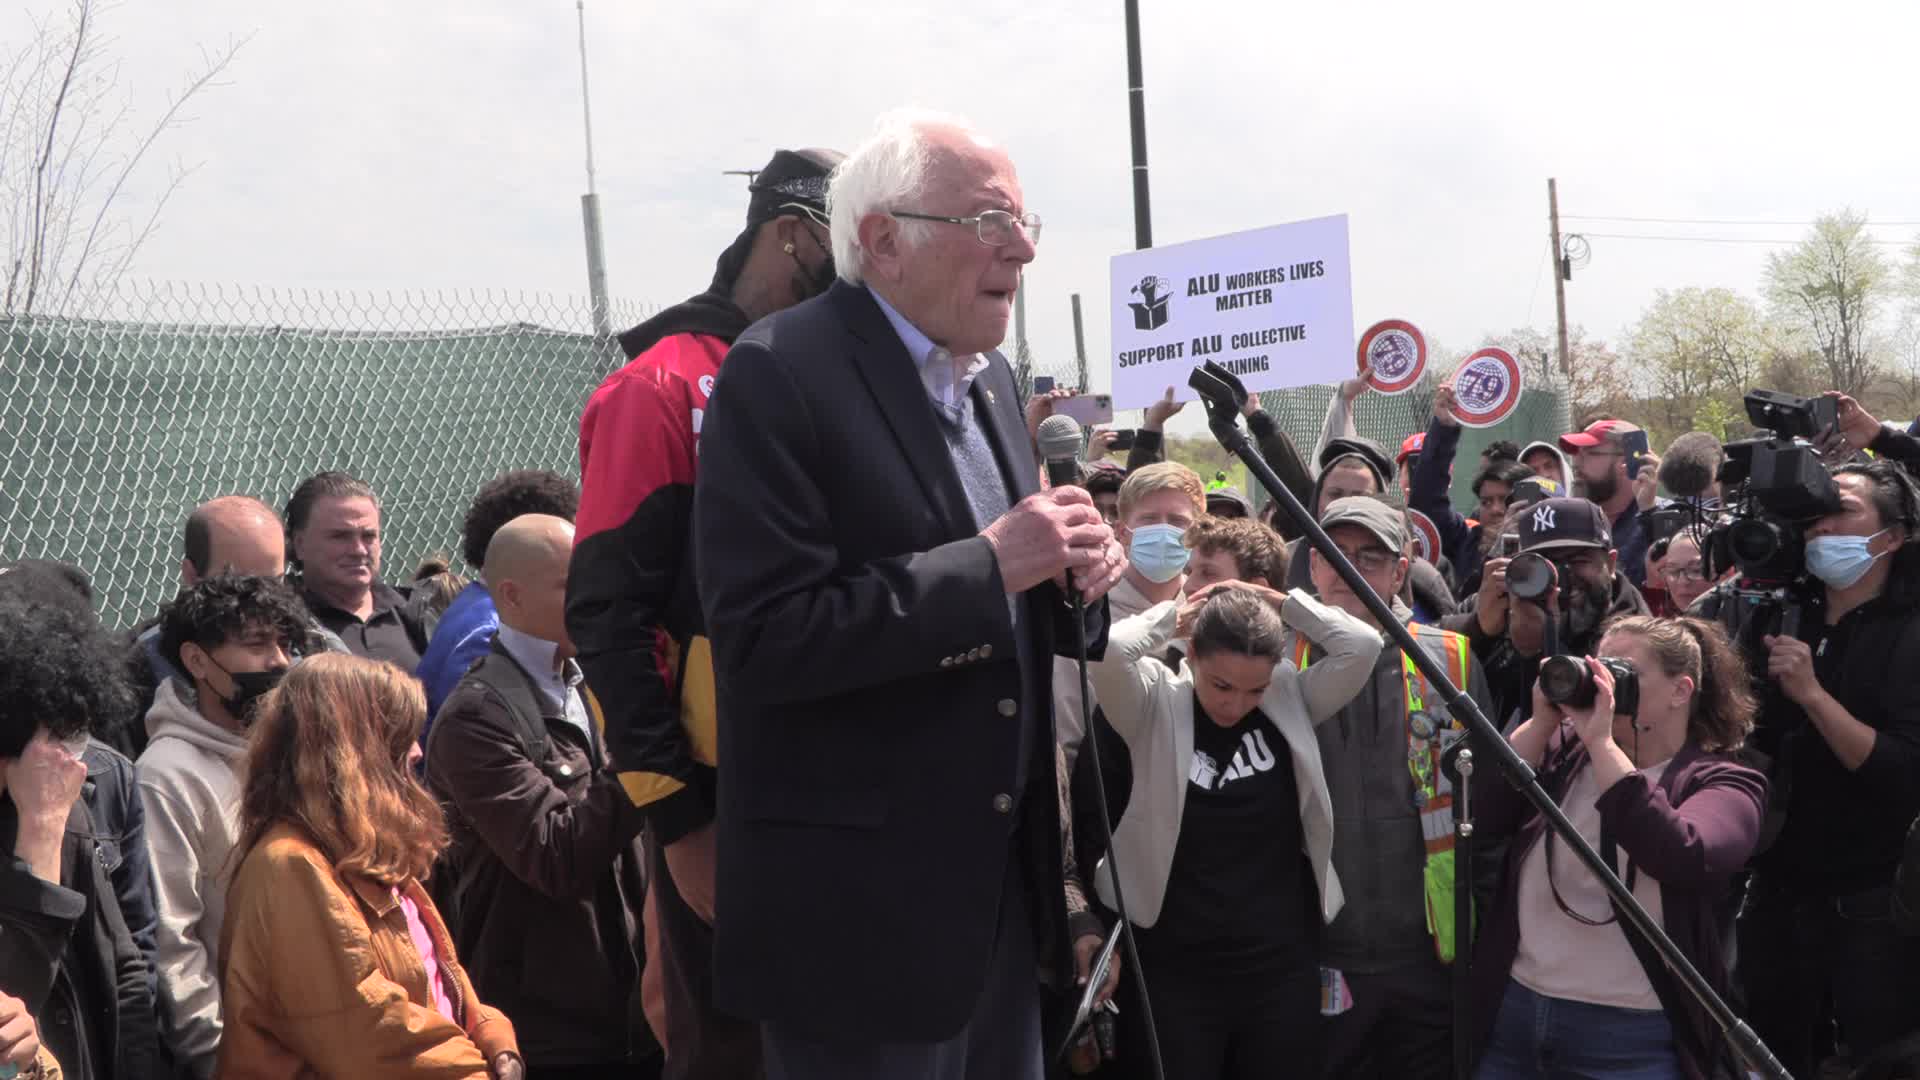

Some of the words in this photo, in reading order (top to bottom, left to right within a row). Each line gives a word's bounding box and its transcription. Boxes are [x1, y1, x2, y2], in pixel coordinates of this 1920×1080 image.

[1187, 273, 1220, 296] ALU
[1226, 267, 1285, 291] WORKERS
[1290, 260, 1324, 281] LIVES
[1216, 288, 1273, 312] MATTER
[1119, 341, 1185, 368] SUPPORT
[1191, 334, 1222, 356] ALU
[1231, 324, 1306, 350] COLLECTIVE
[1218, 728, 1275, 790] ALU
